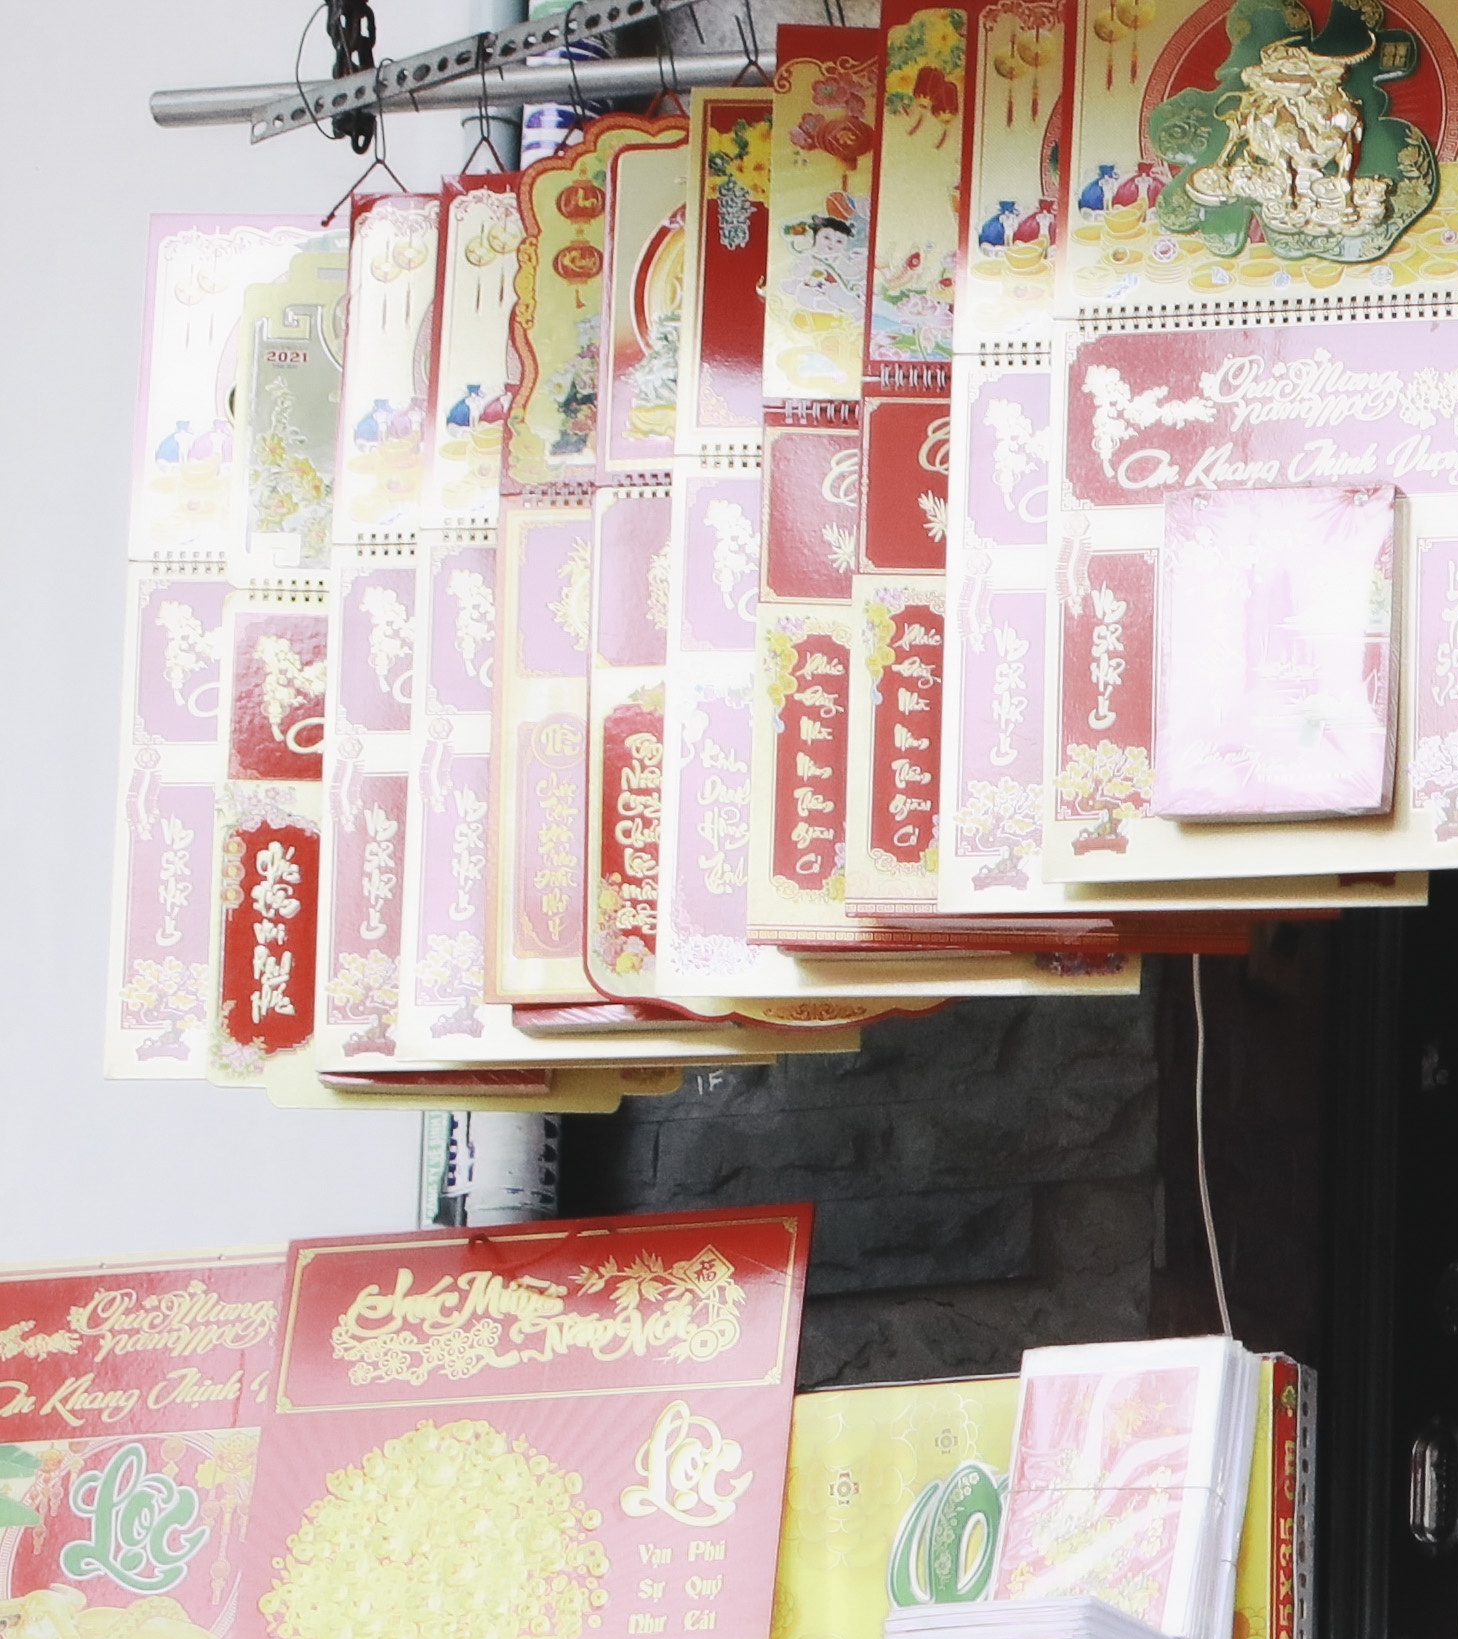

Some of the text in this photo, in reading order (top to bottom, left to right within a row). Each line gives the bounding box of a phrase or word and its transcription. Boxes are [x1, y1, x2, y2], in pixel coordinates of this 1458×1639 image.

[267, 351, 308, 365] 2021
[620, 1399, 755, 1528] Lộc
[637, 1544, 673, 1570] Vạn
[687, 1539, 726, 1563] Phú
[636, 1577, 667, 1604] Sự
[684, 1573, 723, 1601] Quý
[628, 1612, 668, 1635] Như
[683, 1608, 717, 1632] Cát
